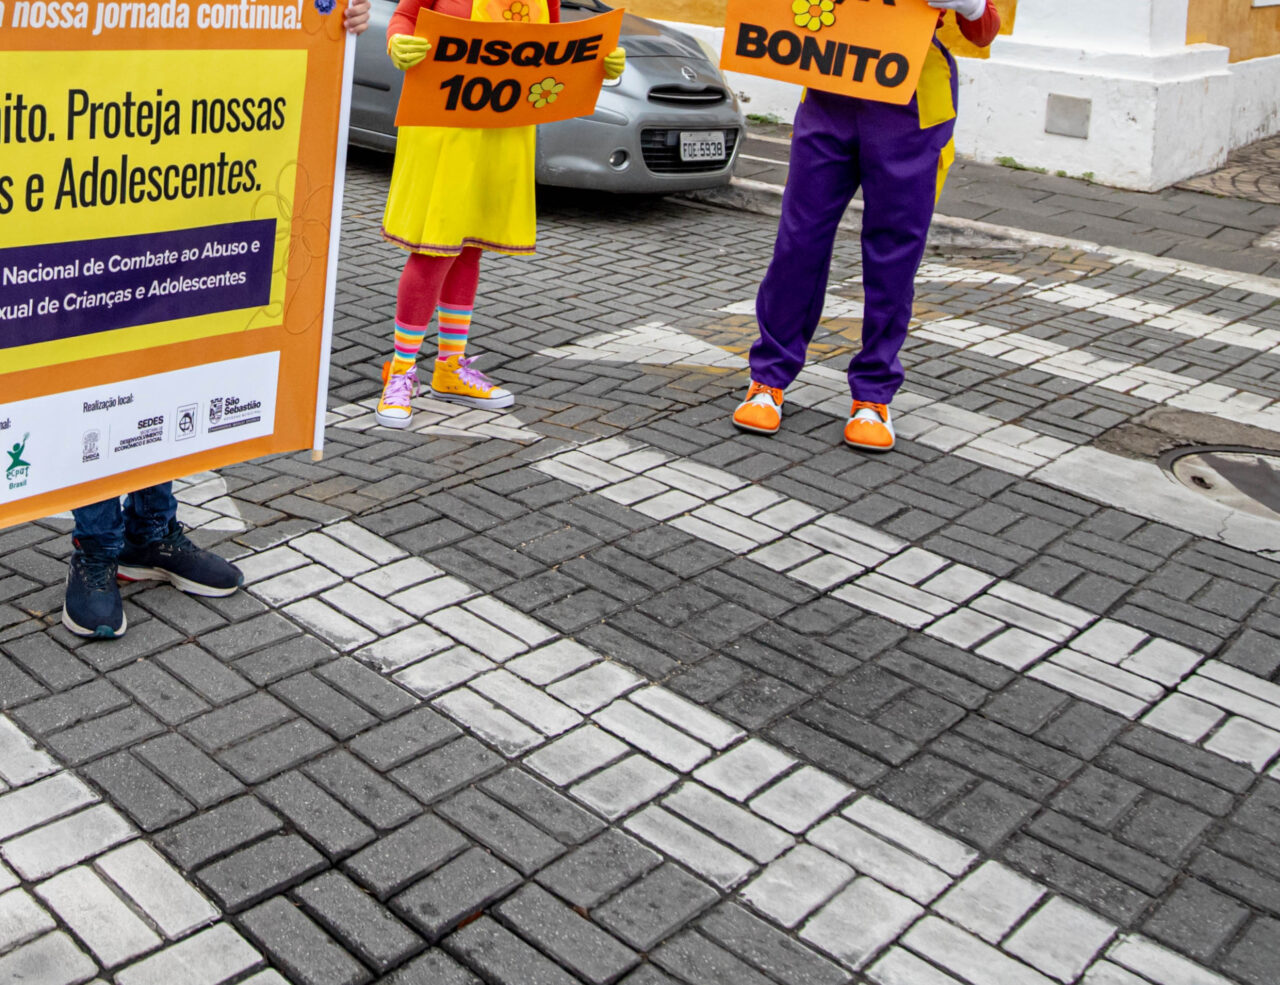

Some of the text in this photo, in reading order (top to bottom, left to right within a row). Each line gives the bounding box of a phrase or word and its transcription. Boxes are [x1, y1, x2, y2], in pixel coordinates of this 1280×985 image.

[11, 1, 88, 29] nossa
[433, 33, 603, 67] DISQUE
[735, 22, 909, 88] BONITO
[439, 74, 521, 113] 100
[67, 88, 180, 145] Proteja
[191, 96, 286, 135] nossas
[25, 173, 44, 213] e
[54, 152, 261, 210] Adolescentes.
[2, 260, 79, 286] Nacional
[83, 258, 104, 276] de
[108, 249, 179, 273] Combate
[181, 247, 199, 262] ao
[201, 240, 248, 259] Abuso
[251, 240, 260, 253] e
[37, 296, 59, 315] de
[63, 286, 132, 309] Crianças
[135, 285, 145, 299] e
[147, 270, 247, 298] Adolescentes
[83, 397, 116, 413] Realização
[224, 400, 261, 416] Sebastião
[225, 396, 240, 407] São
[138, 415, 164, 429] SEDES
[9, 479, 27, 490] Brasil
